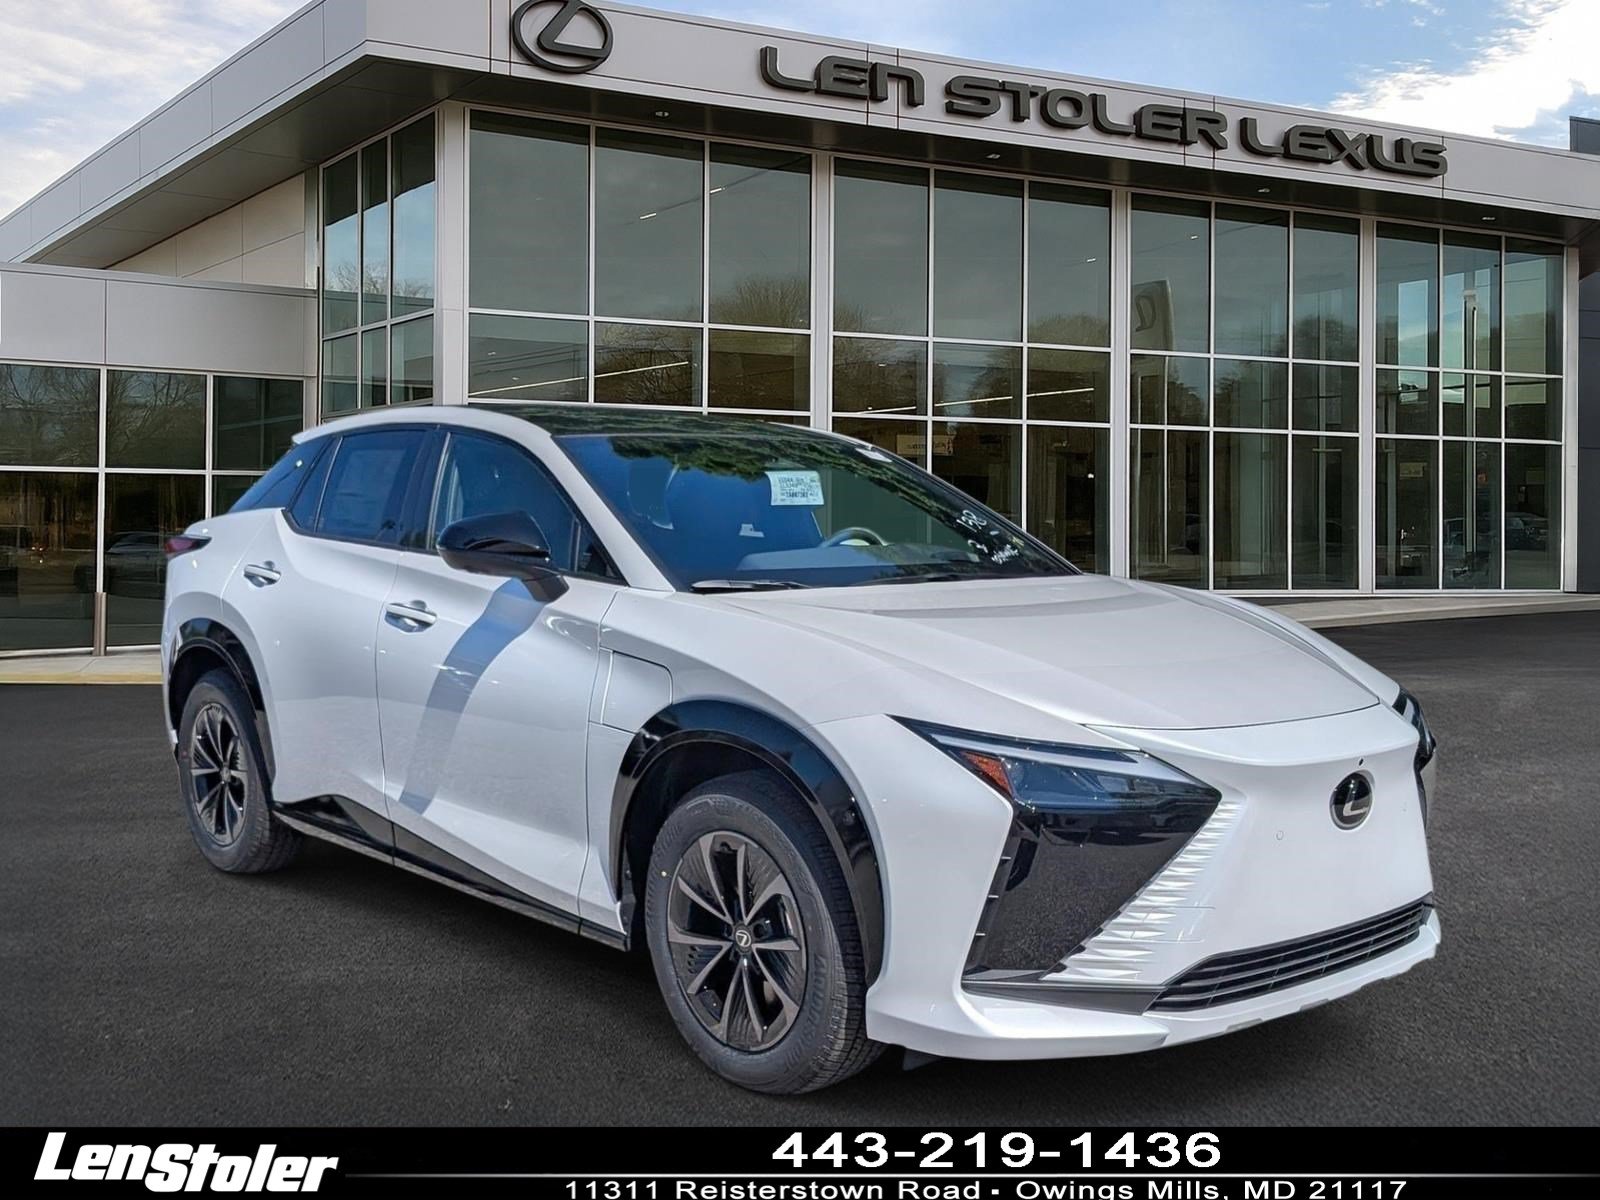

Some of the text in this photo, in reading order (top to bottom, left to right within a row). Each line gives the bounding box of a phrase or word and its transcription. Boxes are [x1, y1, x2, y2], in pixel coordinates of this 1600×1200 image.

[760, 45, 1448, 177] LEN STOLER LEXUS
